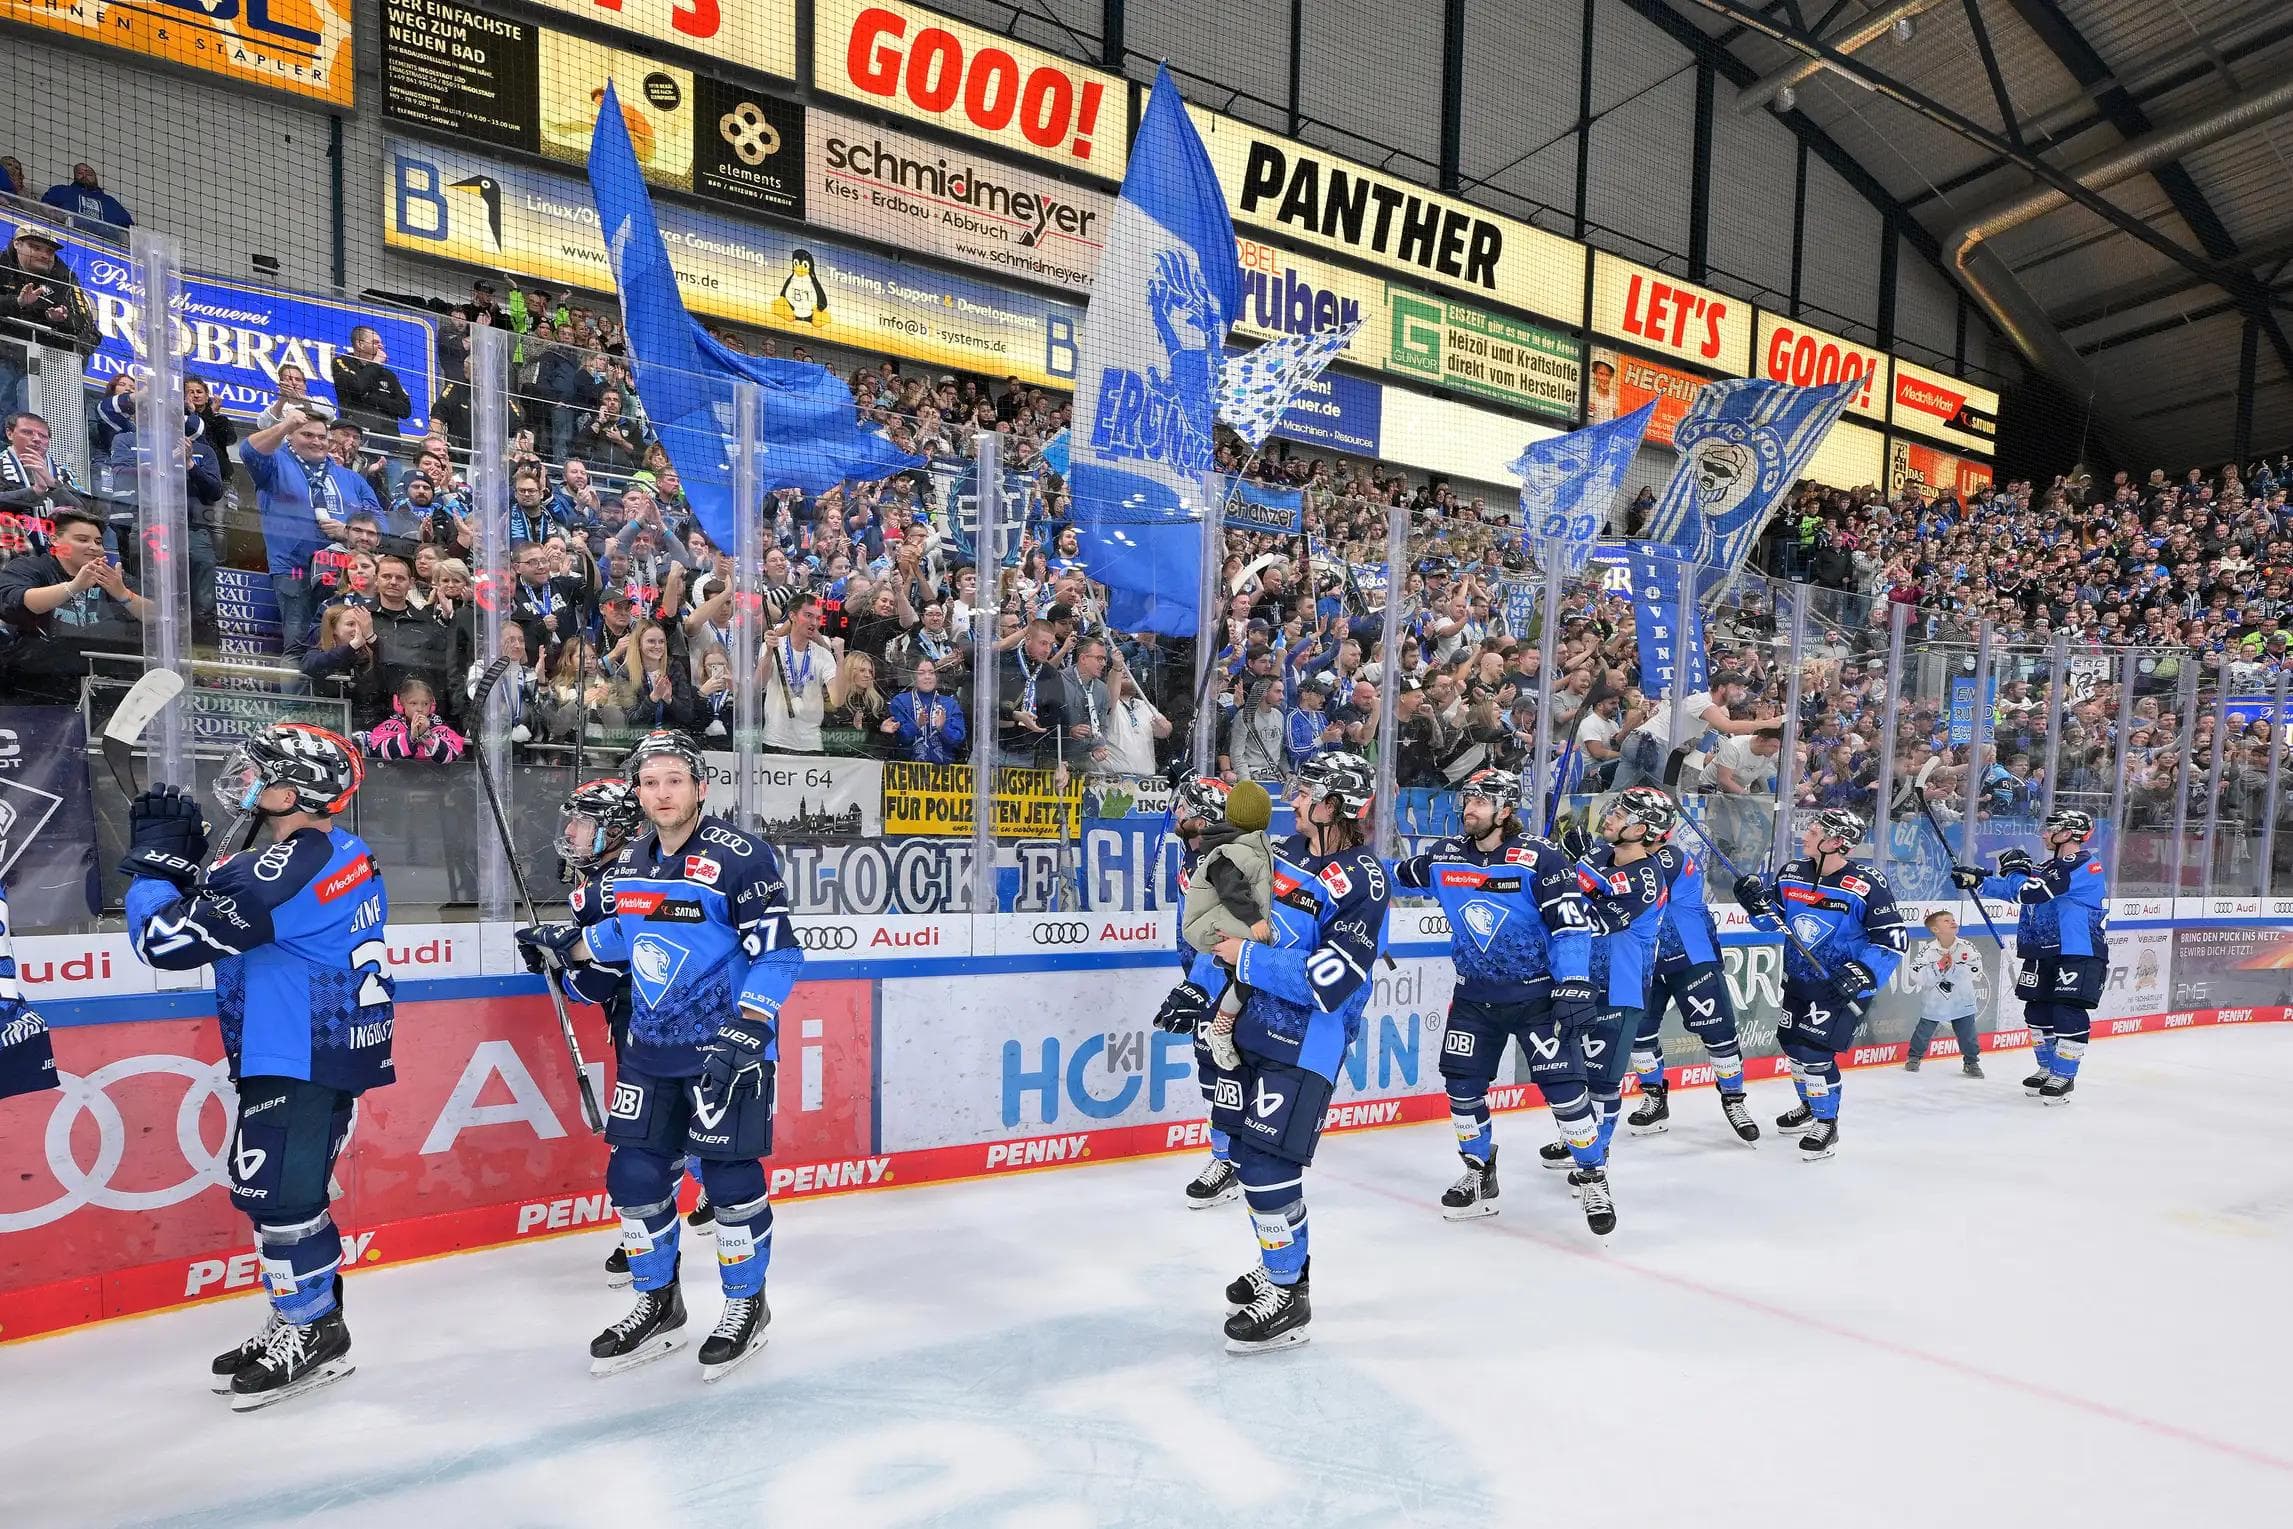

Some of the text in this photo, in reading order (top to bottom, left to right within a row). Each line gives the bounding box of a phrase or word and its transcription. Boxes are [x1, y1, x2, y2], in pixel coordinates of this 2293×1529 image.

[388, 7, 467, 42] WEG ZUM
[426, 1, 522, 41] EINFACHSTE
[389, 25, 486, 64] NEUEN BAD
[846, 8, 1105, 160] GOOO!
[719, 163, 782, 189] elements
[825, 138, 1096, 239] schmidmeyer
[825, 178, 1009, 242] Kies Erdbau Abbruch
[1239, 139, 1504, 291] PANTHER
[827, 265, 886, 295] Training,
[887, 281, 940, 307] Support
[957, 298, 1038, 329] Development
[1622, 274, 1728, 359] LET'S
[1393, 347, 1438, 370] GUNVOR
[1448, 329, 1578, 383] Heizöl und Kraftstoffe
[1448, 353, 1485, 380] direkt
[1490, 367, 1515, 388] vom
[1520, 372, 1578, 404] Hersteller
[805, 768, 833, 789] 64
[886, 791, 921, 821] FÜR
[1541, 875, 1561, 888] Café
[1557, 900, 1585, 926] 19
[2143, 903, 2162, 915] Audi
[2236, 902, 2257, 914] Audi
[870, 925, 940, 948] Audi
[1100, 921, 1158, 941] Audi
[2202, 932, 2218, 943] DEN
[2219, 932, 2241, 942] PUCK
[2242, 931, 2256, 942] INS
[2258, 931, 2280, 941] NETZ
[2207, 945, 2225, 956] DICH
[20, 952, 112, 985] udi
[1306, 947, 1346, 987] 10
[1446, 1032, 1471, 1053] DB
[1217, 1082, 1239, 1106] DB
